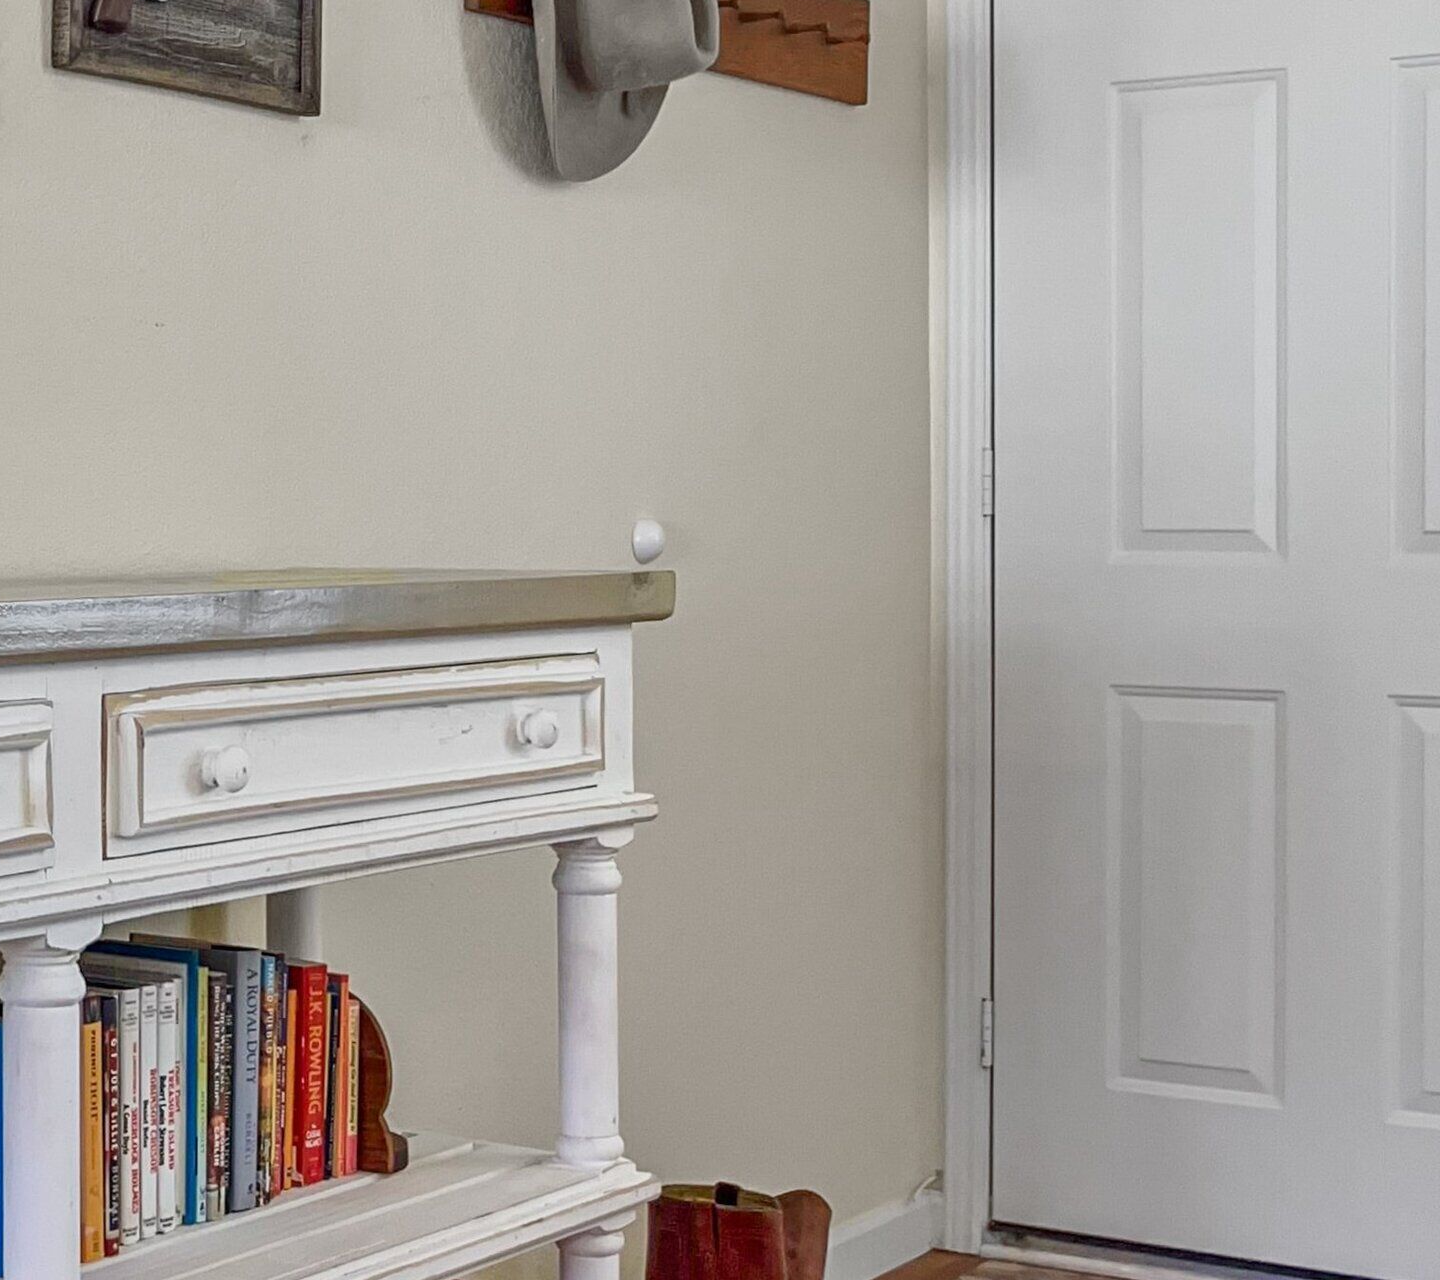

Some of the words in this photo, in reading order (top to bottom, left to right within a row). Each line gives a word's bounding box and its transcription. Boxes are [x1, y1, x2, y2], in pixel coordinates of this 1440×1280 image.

[247, 968, 257, 982] A
[247, 984, 258, 1037] ROYAL
[308, 986, 323, 1021] J.K.
[246, 1040, 258, 1086] DUTY
[308, 1025, 323, 1115] ROWLING
[159, 1075, 167, 1102] Robert
[167, 1069, 175, 1126] TREASURE
[131, 1107, 139, 1165] SHERLOCK
[167, 1129, 175, 1171] ISLAND
[131, 1168, 139, 1214] HOLMES
